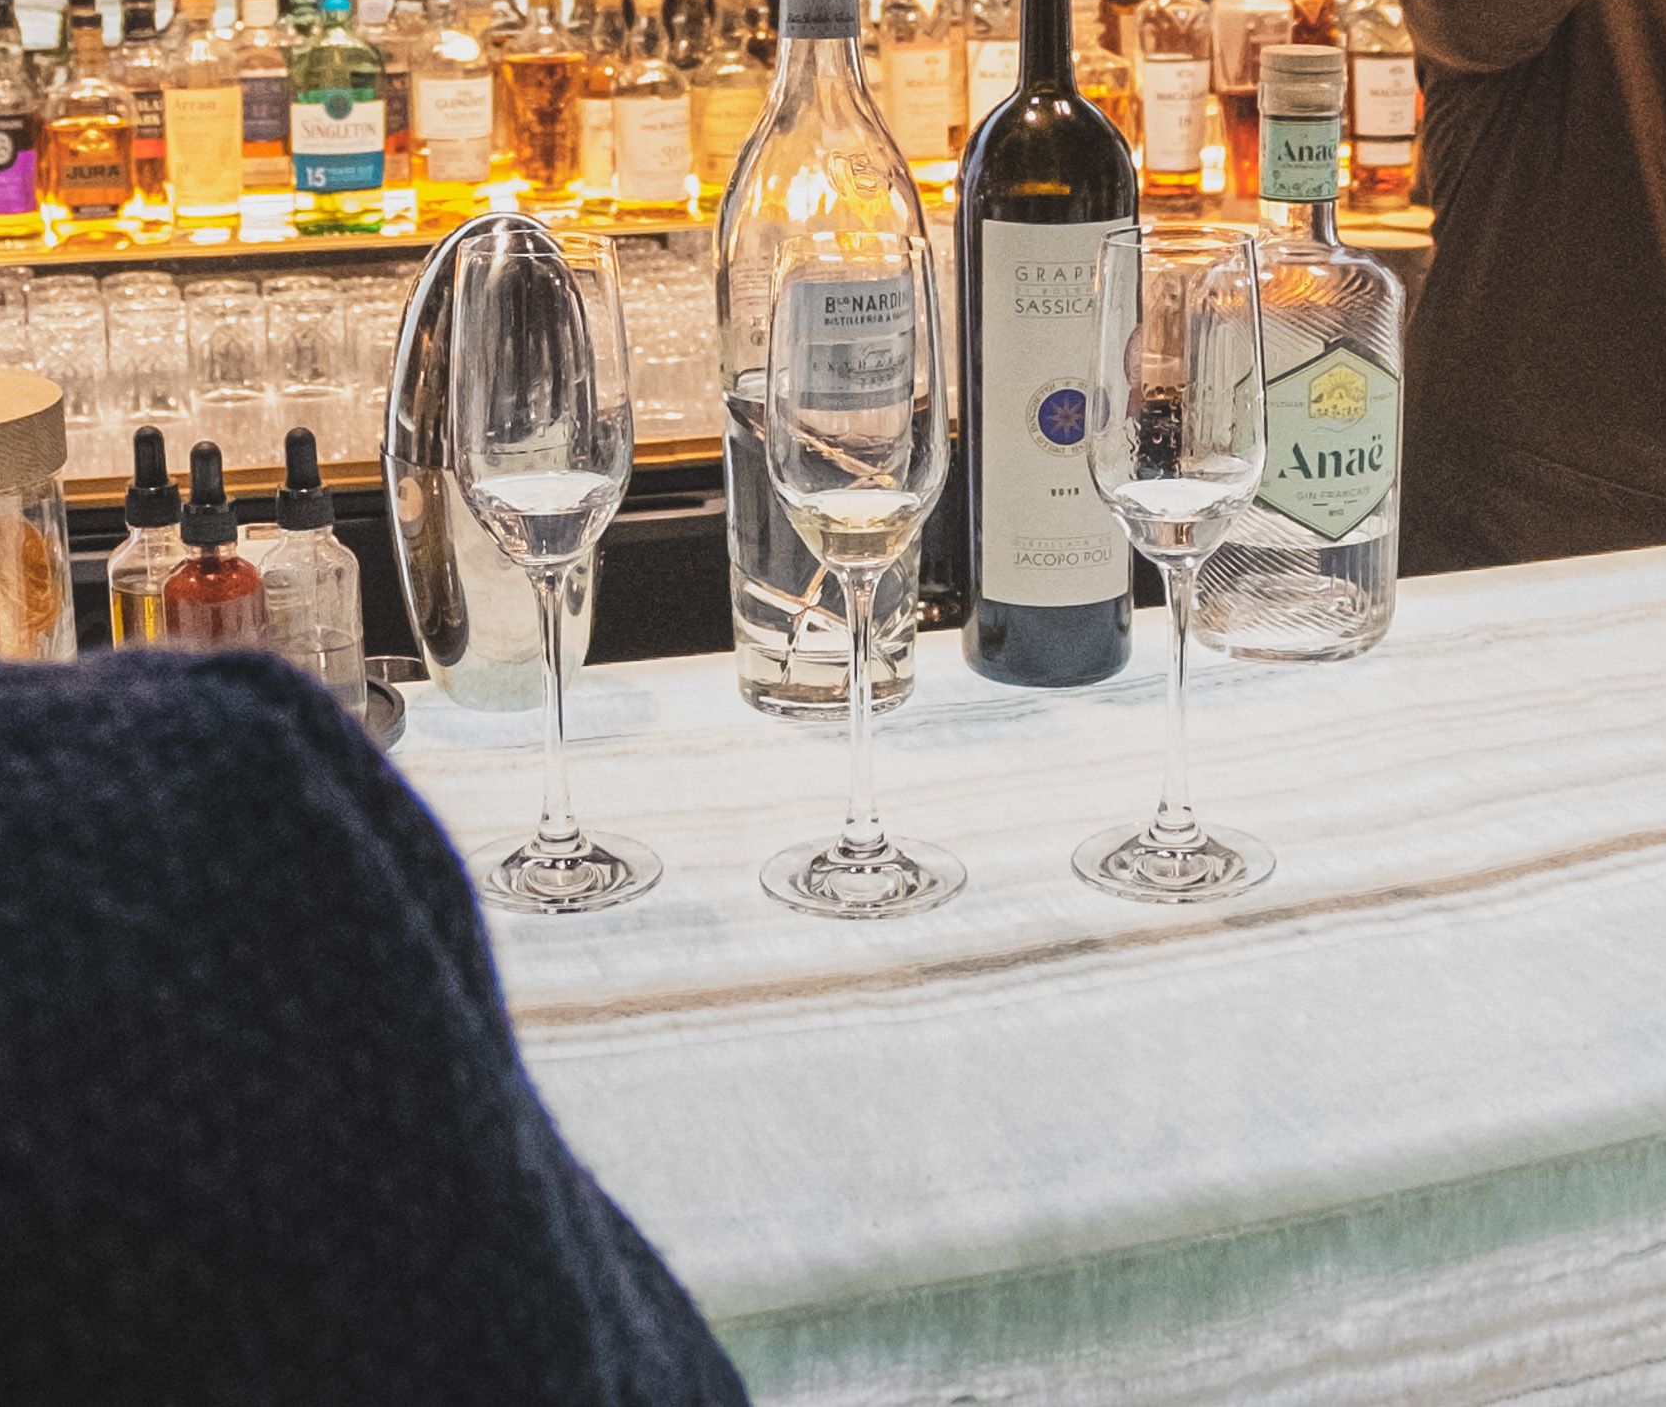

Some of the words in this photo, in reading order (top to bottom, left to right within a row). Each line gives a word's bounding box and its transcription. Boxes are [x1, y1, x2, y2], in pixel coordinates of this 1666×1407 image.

[301, 120, 377, 139] SINGLETON
[65, 165, 120, 181] JURA
[305, 165, 328, 188] 15
[1015, 265, 1097, 282] GRAPP
[852, 290, 907, 313] NARDI
[1015, 297, 1096, 315] SASSICA
[1278, 434, 1384, 480] Anaë
[1014, 550, 1079, 567] JACOPO
[1083, 546, 1113, 563] POLI
